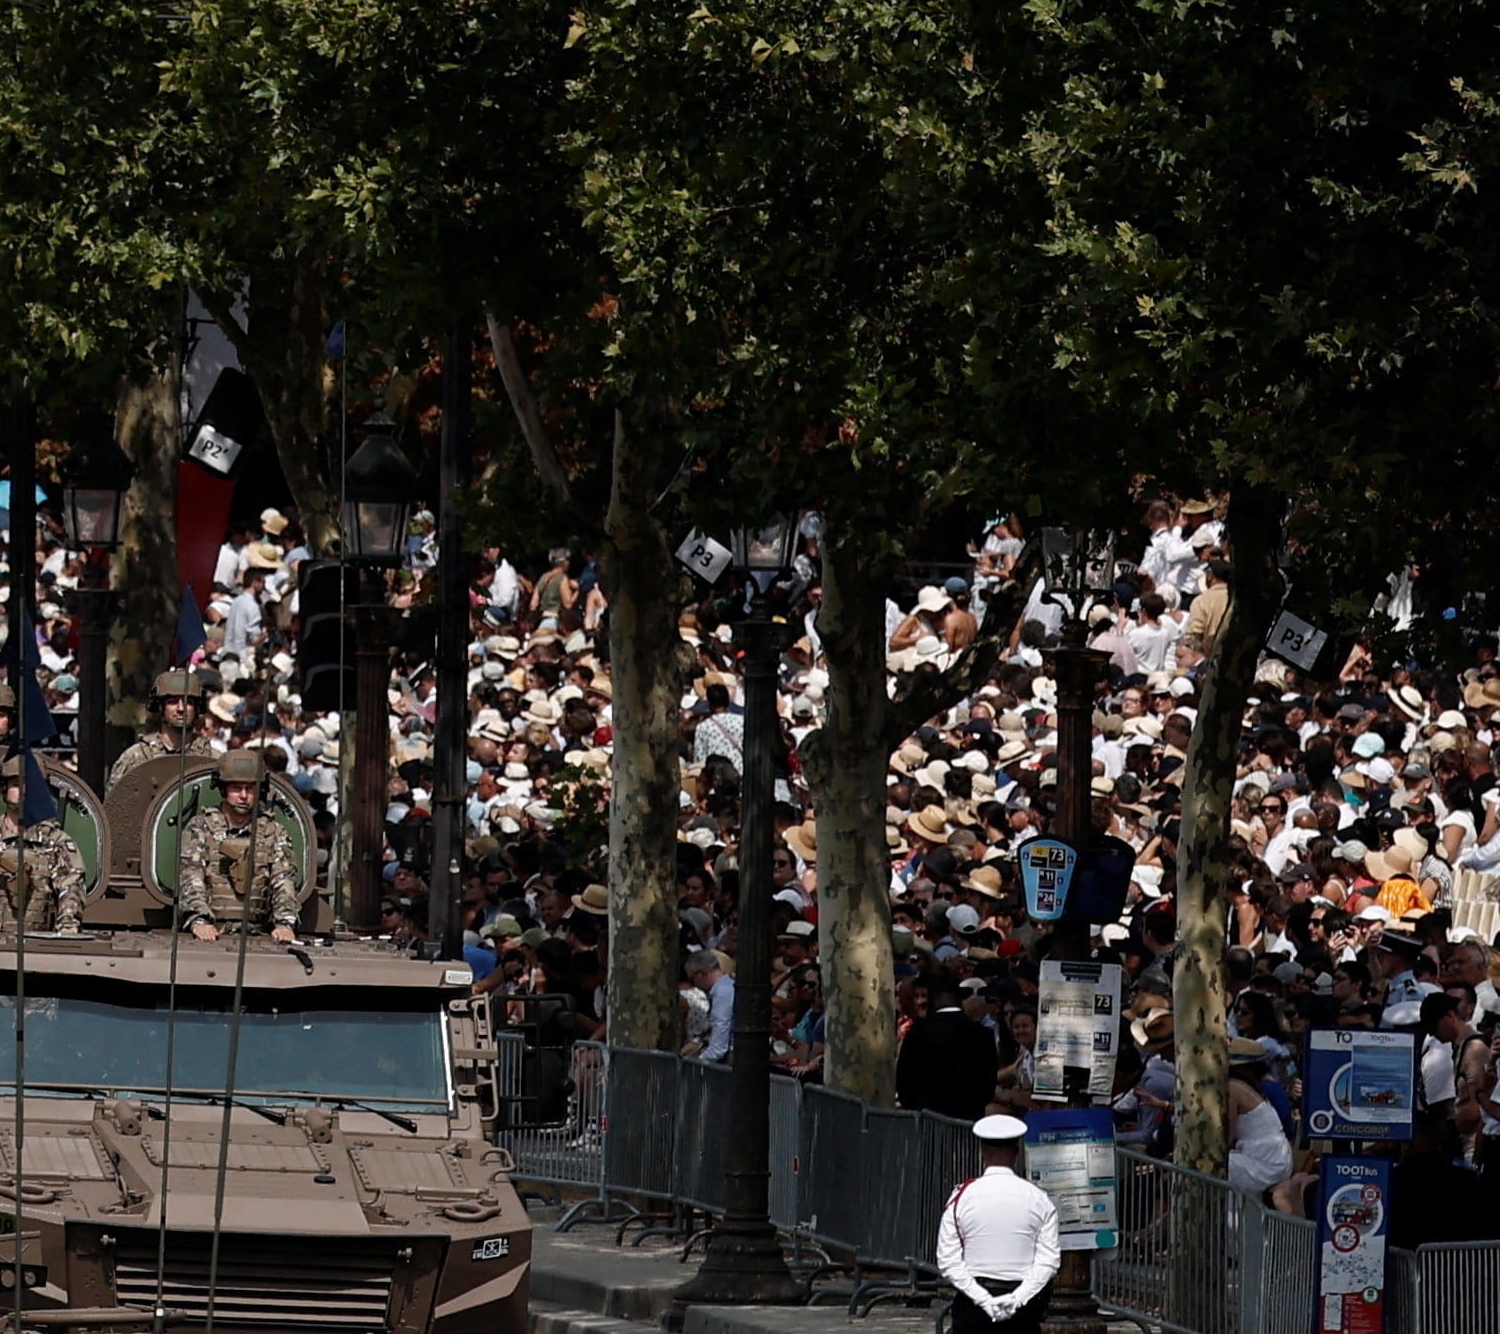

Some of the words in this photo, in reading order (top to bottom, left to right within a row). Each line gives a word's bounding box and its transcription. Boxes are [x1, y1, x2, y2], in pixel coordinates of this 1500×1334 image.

[691, 545, 713, 567] P3
[1051, 849, 1064, 861] 73
[1097, 996, 1110, 1007] 73
